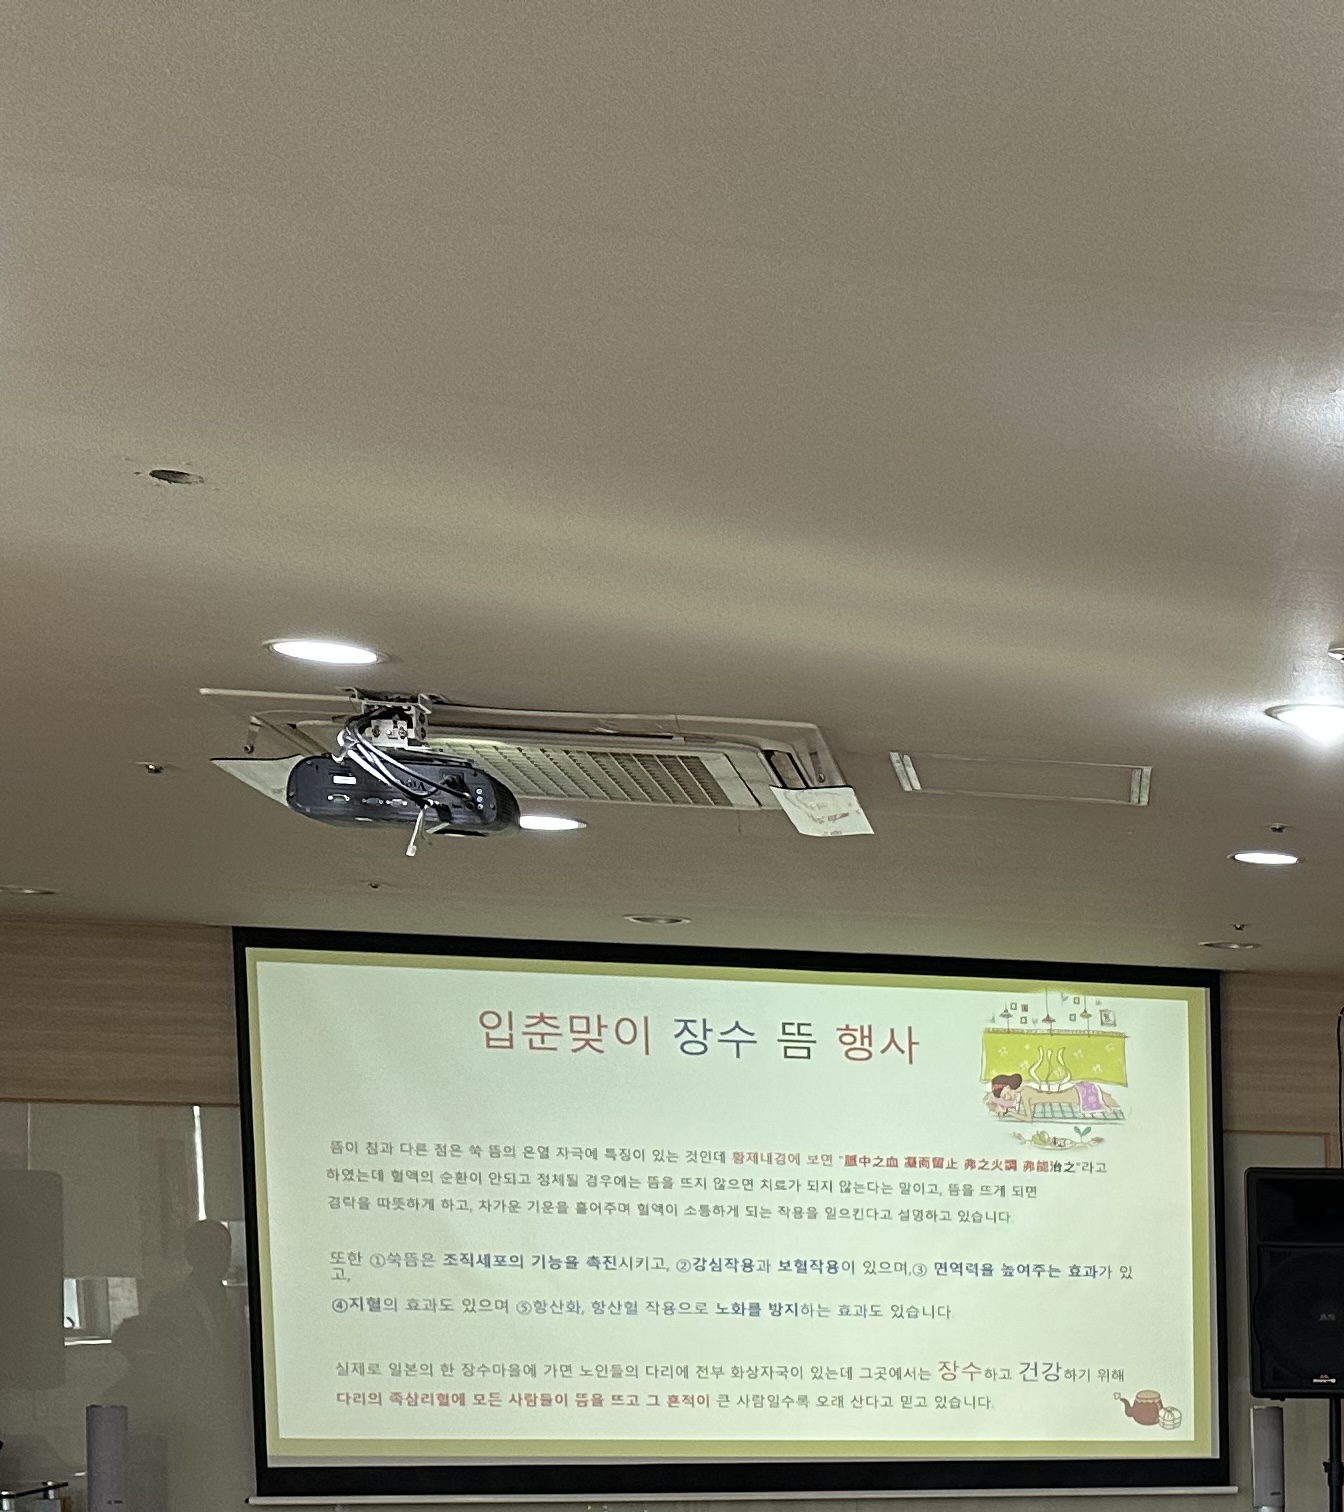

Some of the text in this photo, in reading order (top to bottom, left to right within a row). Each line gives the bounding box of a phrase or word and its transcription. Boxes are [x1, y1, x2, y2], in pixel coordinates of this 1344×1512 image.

[478, 1010, 919, 1065] 입춘맞이 장수 뜸 행사
[330, 1251, 362, 1267] 또한
[443, 1252, 524, 1269] 조직세포의
[532, 1254, 580, 1270] 기능을
[586, 1255, 670, 1272] 촉진시키고,
[676, 1256, 771, 1274] ②강심작용과
[778, 1258, 855, 1276] 보혈작용이
[934, 1261, 994, 1277] 면역력을
[1068, 1264, 1112, 1279] 효과가
[1120, 1266, 1134, 1280] 있
[331, 1268, 351, 1282] 고,
[406, 1298, 454, 1312] 효과도
[462, 1299, 509, 1314] 있으며
[646, 1302, 708, 1316] 작용으로
[715, 1302, 760, 1317] 노화를
[768, 1302, 830, 1318] 방지하는
[838, 1304, 884, 1318] 효과도
[336, 1360, 1125, 1382] 실제로 일본의 한 장수마을에 가면 노인들의 다리에 전부 화상자국이 있는데 그곳에서는 장수하고 건강하기 위해
